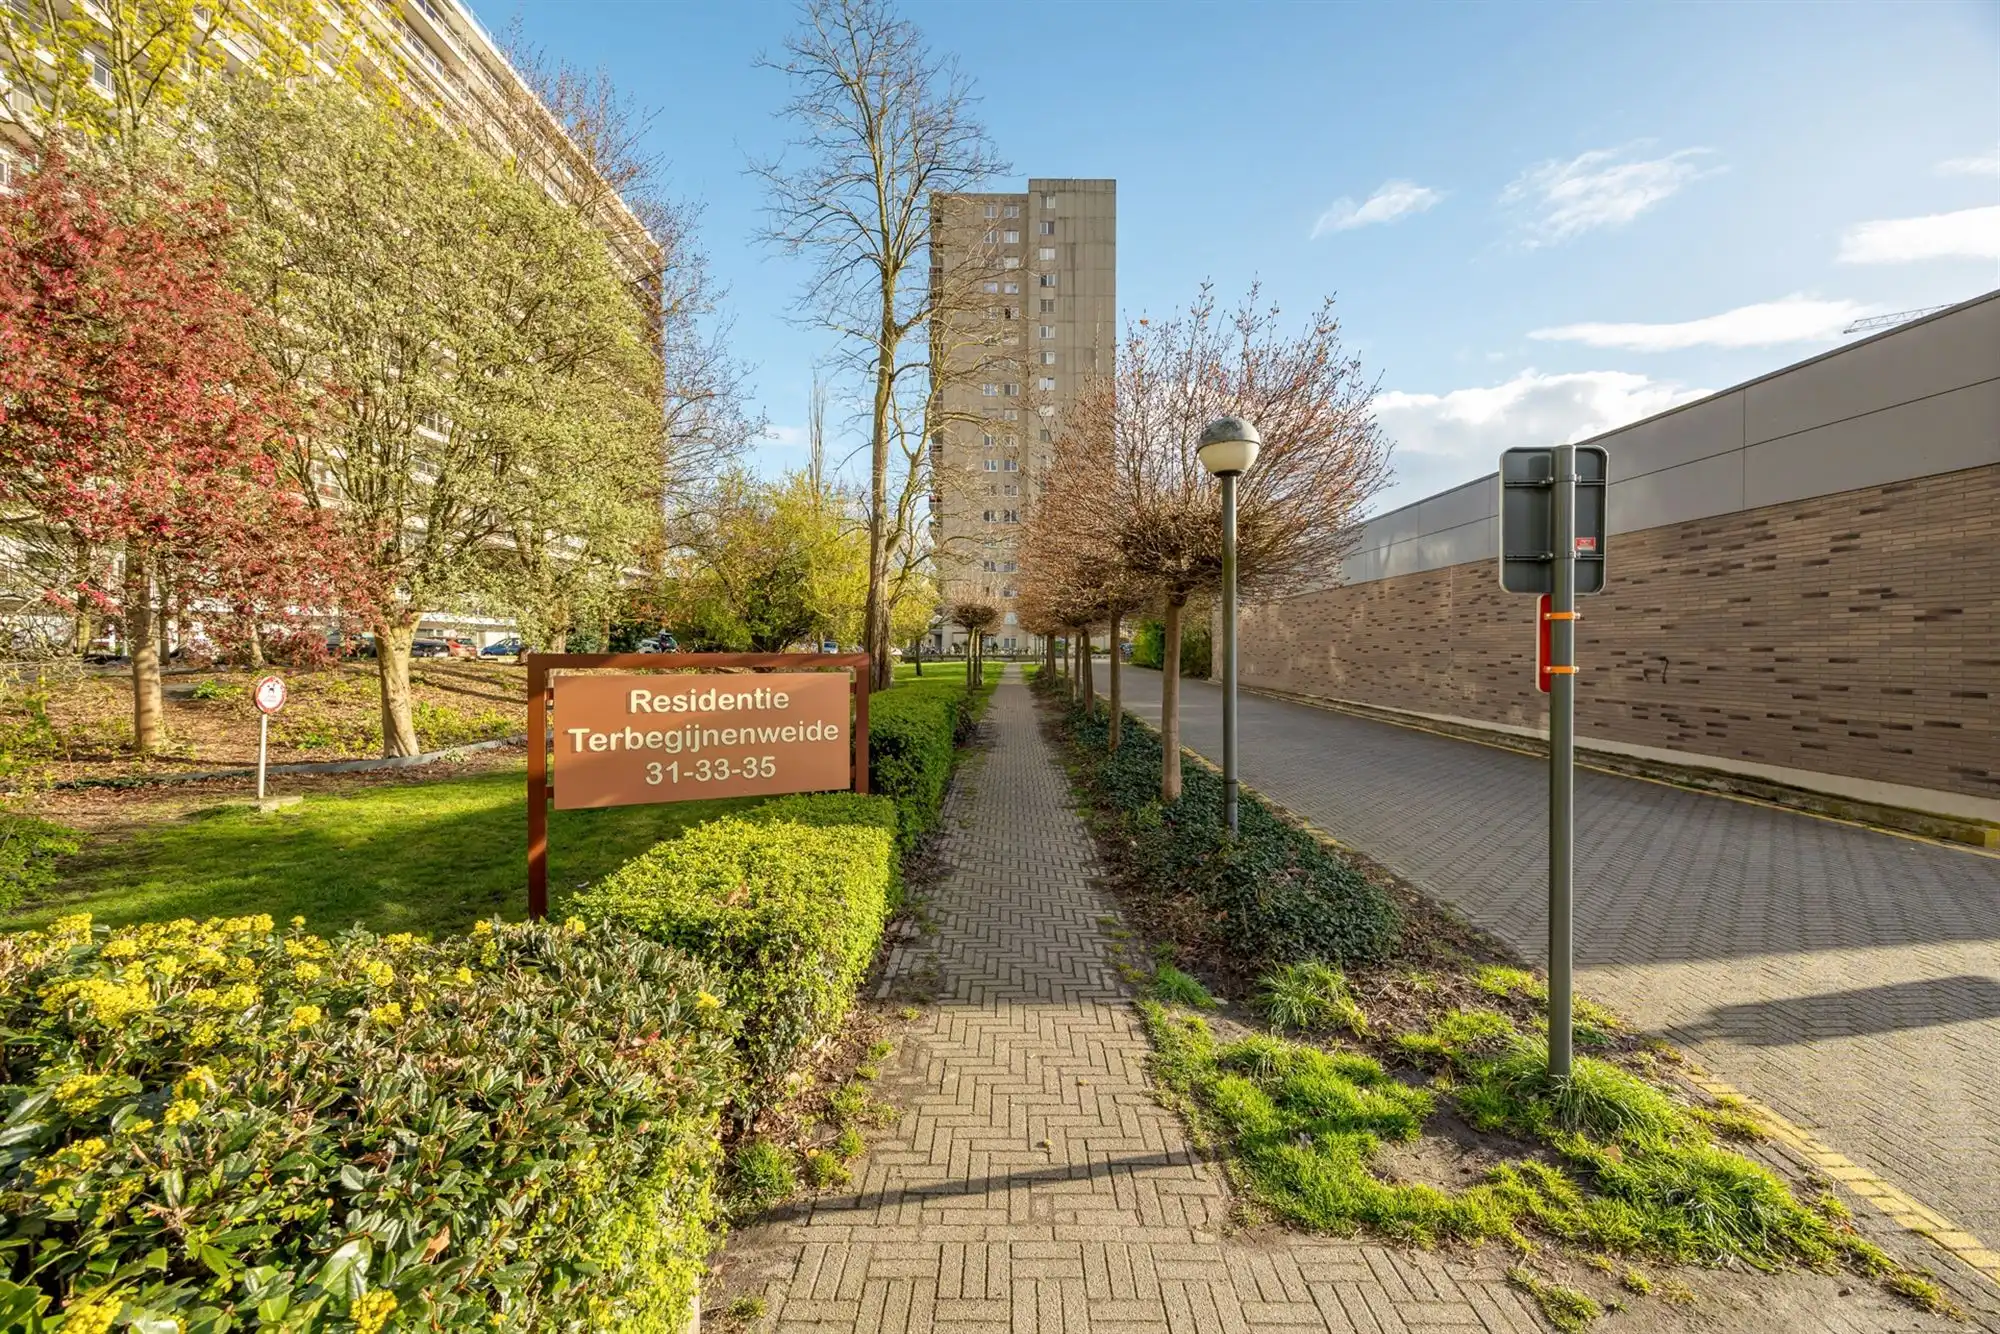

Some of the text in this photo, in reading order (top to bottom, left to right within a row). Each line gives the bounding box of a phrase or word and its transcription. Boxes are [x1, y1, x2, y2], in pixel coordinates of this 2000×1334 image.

[629, 688, 789, 714] Residentie
[567, 720, 839, 753] Terbegijnenweide
[645, 756, 776, 785] 31-33-35
